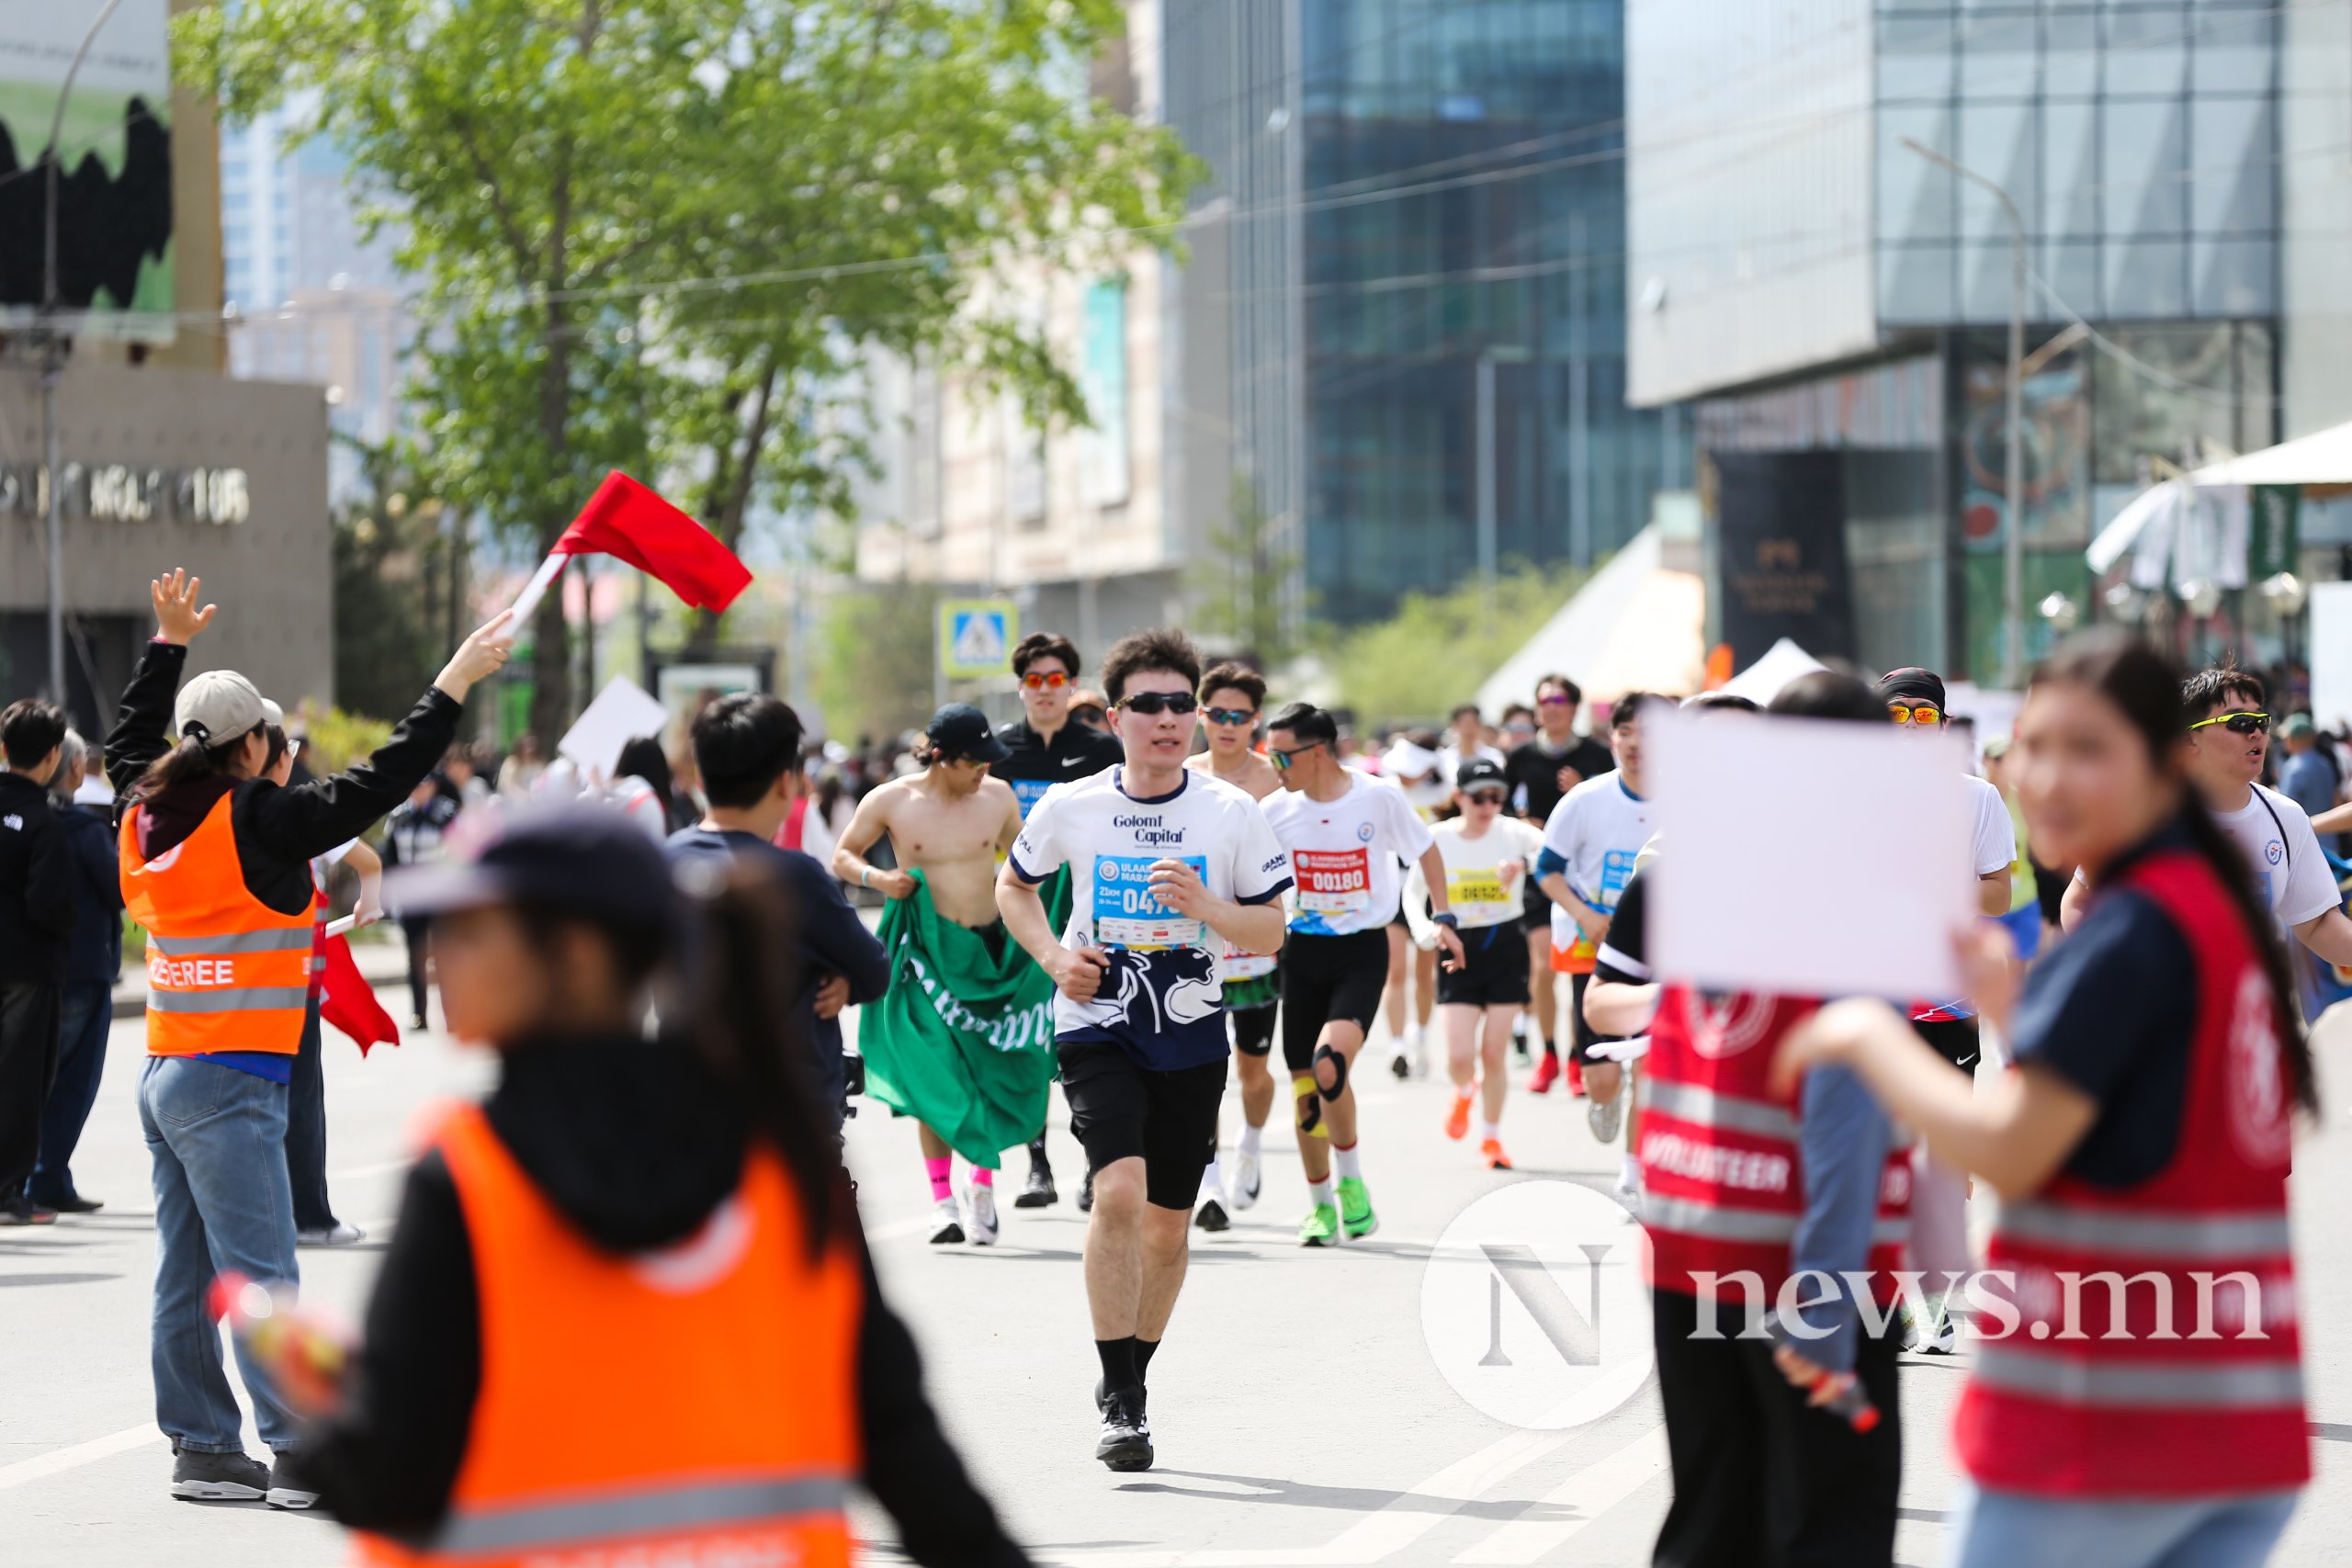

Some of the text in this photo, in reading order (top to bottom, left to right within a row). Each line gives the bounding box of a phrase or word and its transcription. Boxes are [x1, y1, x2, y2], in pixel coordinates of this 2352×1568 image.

[1114, 815, 1162, 828] Golomt
[1135, 828, 1182, 846] Capital
[1313, 870, 1363, 891] 00180
